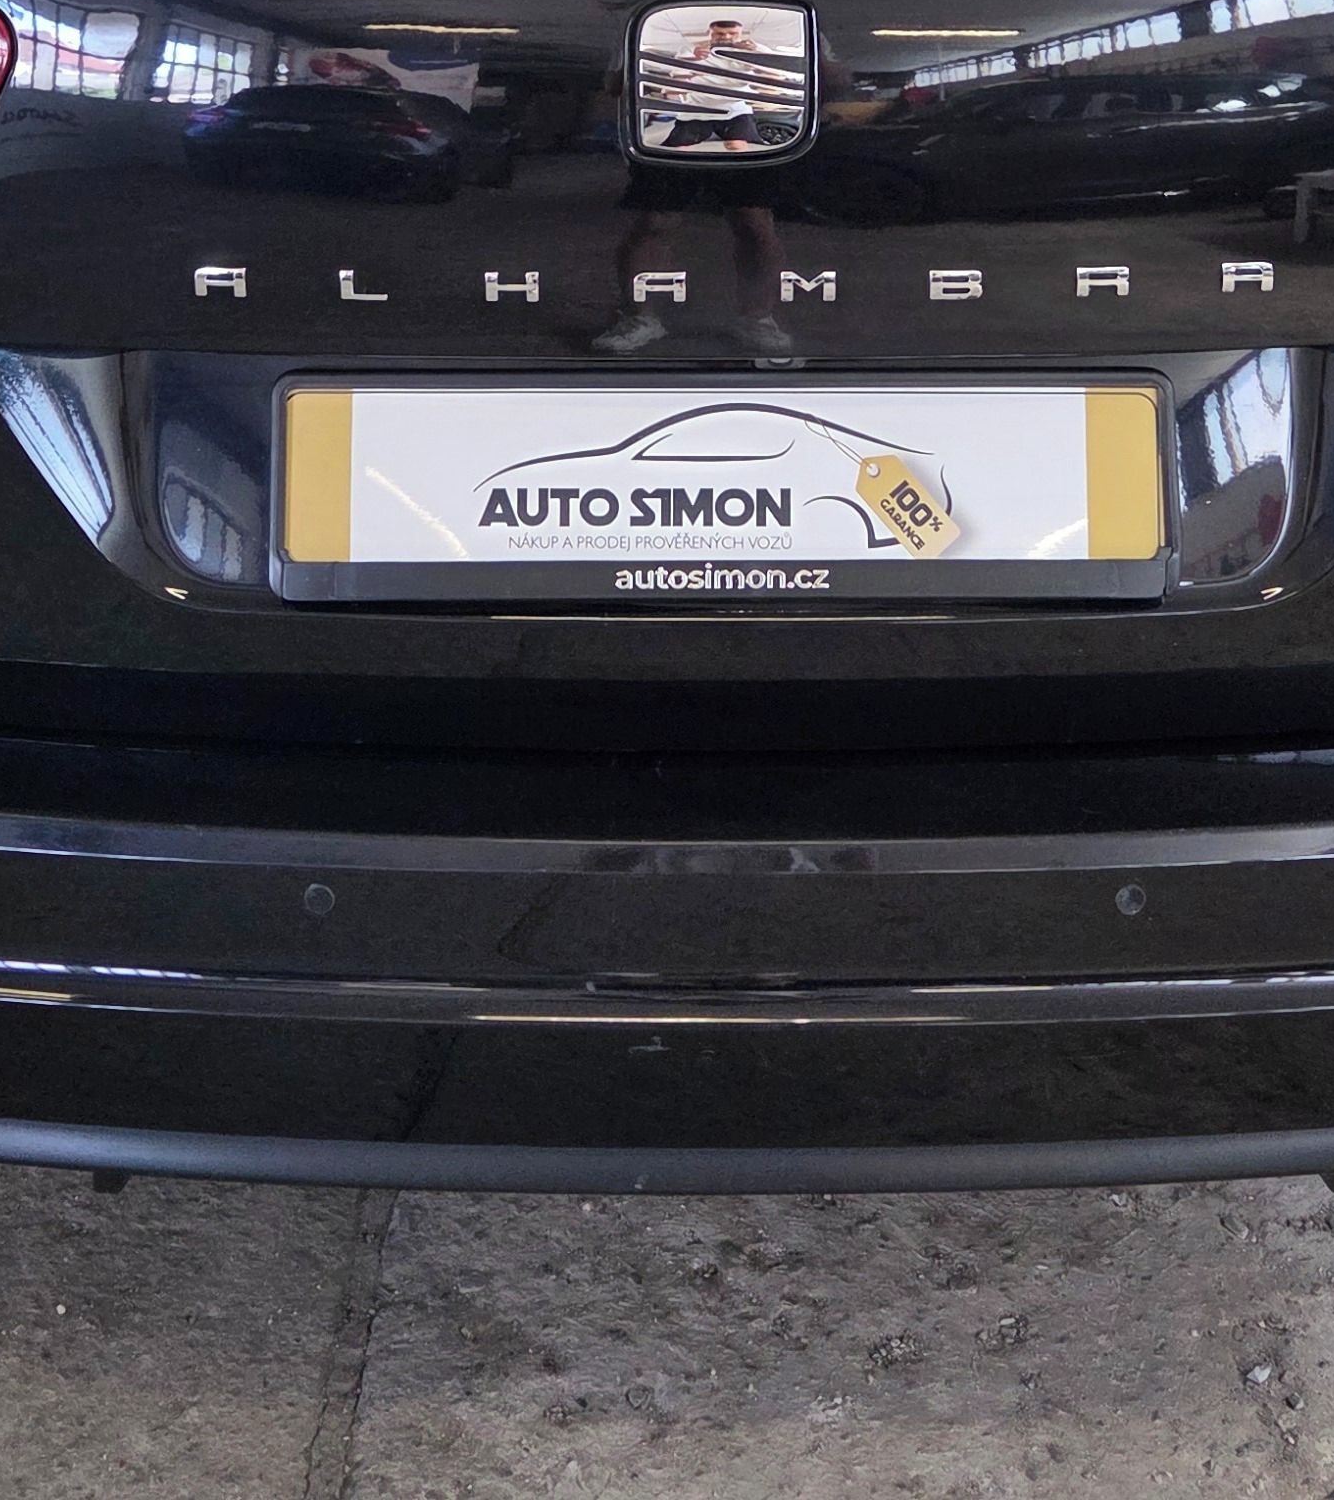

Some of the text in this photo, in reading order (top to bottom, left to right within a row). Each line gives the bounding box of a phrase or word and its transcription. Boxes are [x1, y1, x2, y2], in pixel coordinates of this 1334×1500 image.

[193, 259, 1275, 304] ALHAMBRA
[478, 487, 792, 527] AUTO SIMON
[880, 499, 926, 551] GARANCE
[889, 480, 944, 532] 100%
[508, 531, 793, 552] NÁKUP A PRODEJ PROVĚŘENÝCH VOZŮ
[615, 562, 830, 590] autosimon.cz
